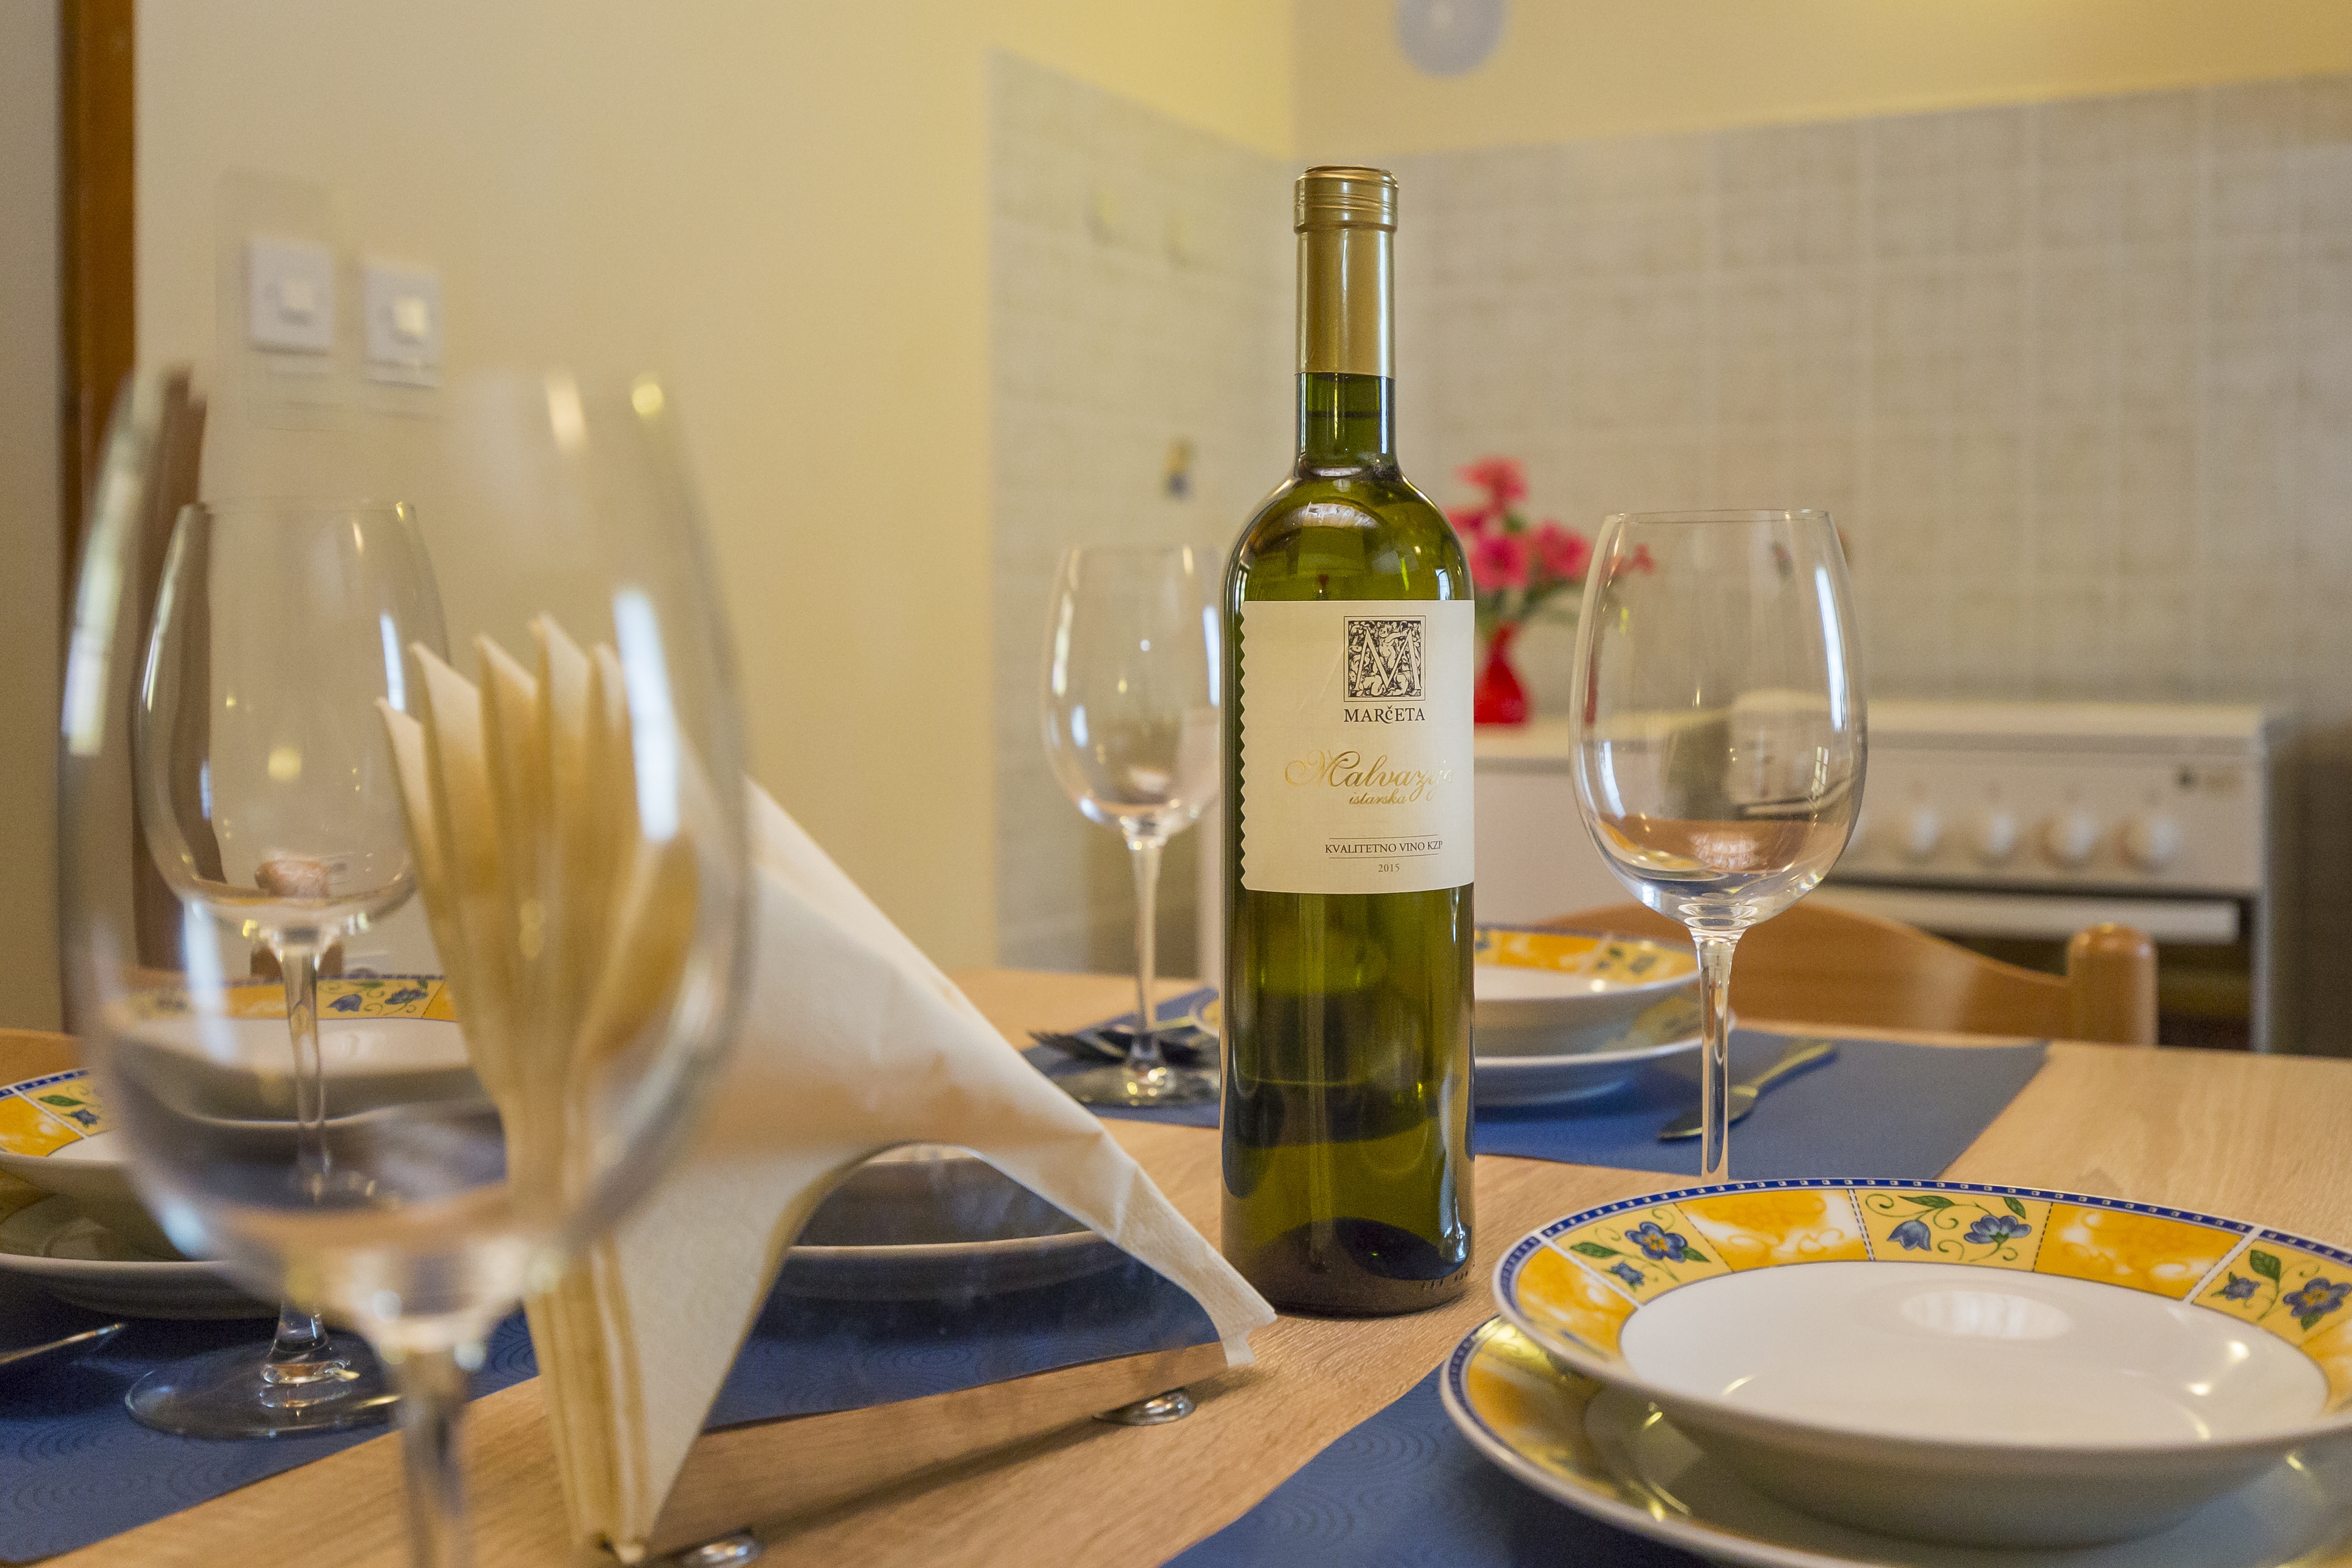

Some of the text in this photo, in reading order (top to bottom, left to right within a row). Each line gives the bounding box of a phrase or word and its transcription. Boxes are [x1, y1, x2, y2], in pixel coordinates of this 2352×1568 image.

[1349, 788, 1407, 805] istarska
[1325, 840, 1443, 854] KVALITETNO VINO KZP
[1378, 863, 1401, 872] 2015
